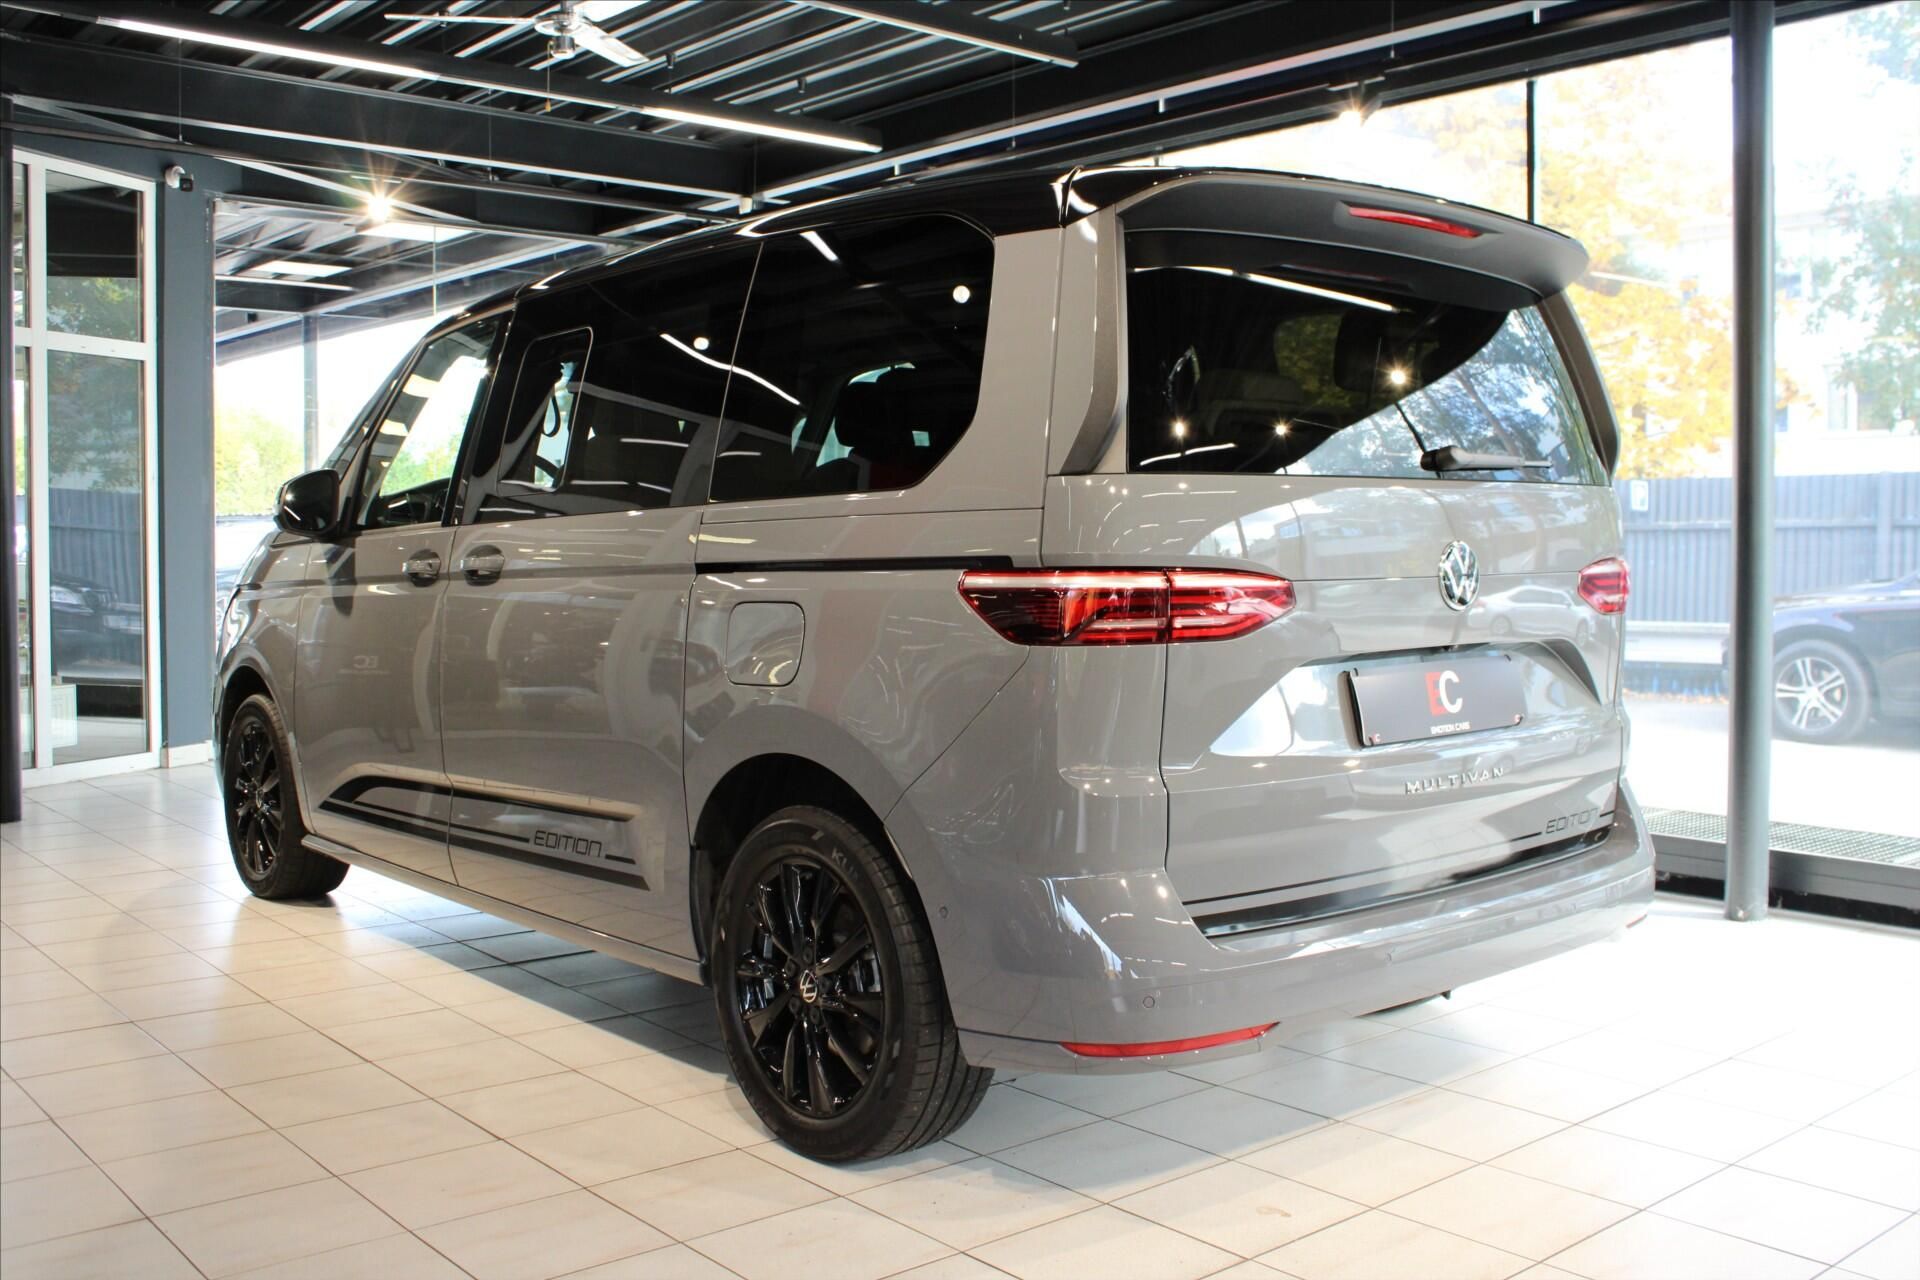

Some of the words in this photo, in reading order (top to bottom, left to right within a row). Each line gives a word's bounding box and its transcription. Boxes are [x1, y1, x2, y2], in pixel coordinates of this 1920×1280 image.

[1425, 670, 1463, 717] EC
[1405, 767, 1504, 795] MULTIVAN
[1546, 807, 1599, 834] EDITION
[533, 829, 603, 858] EDITION
